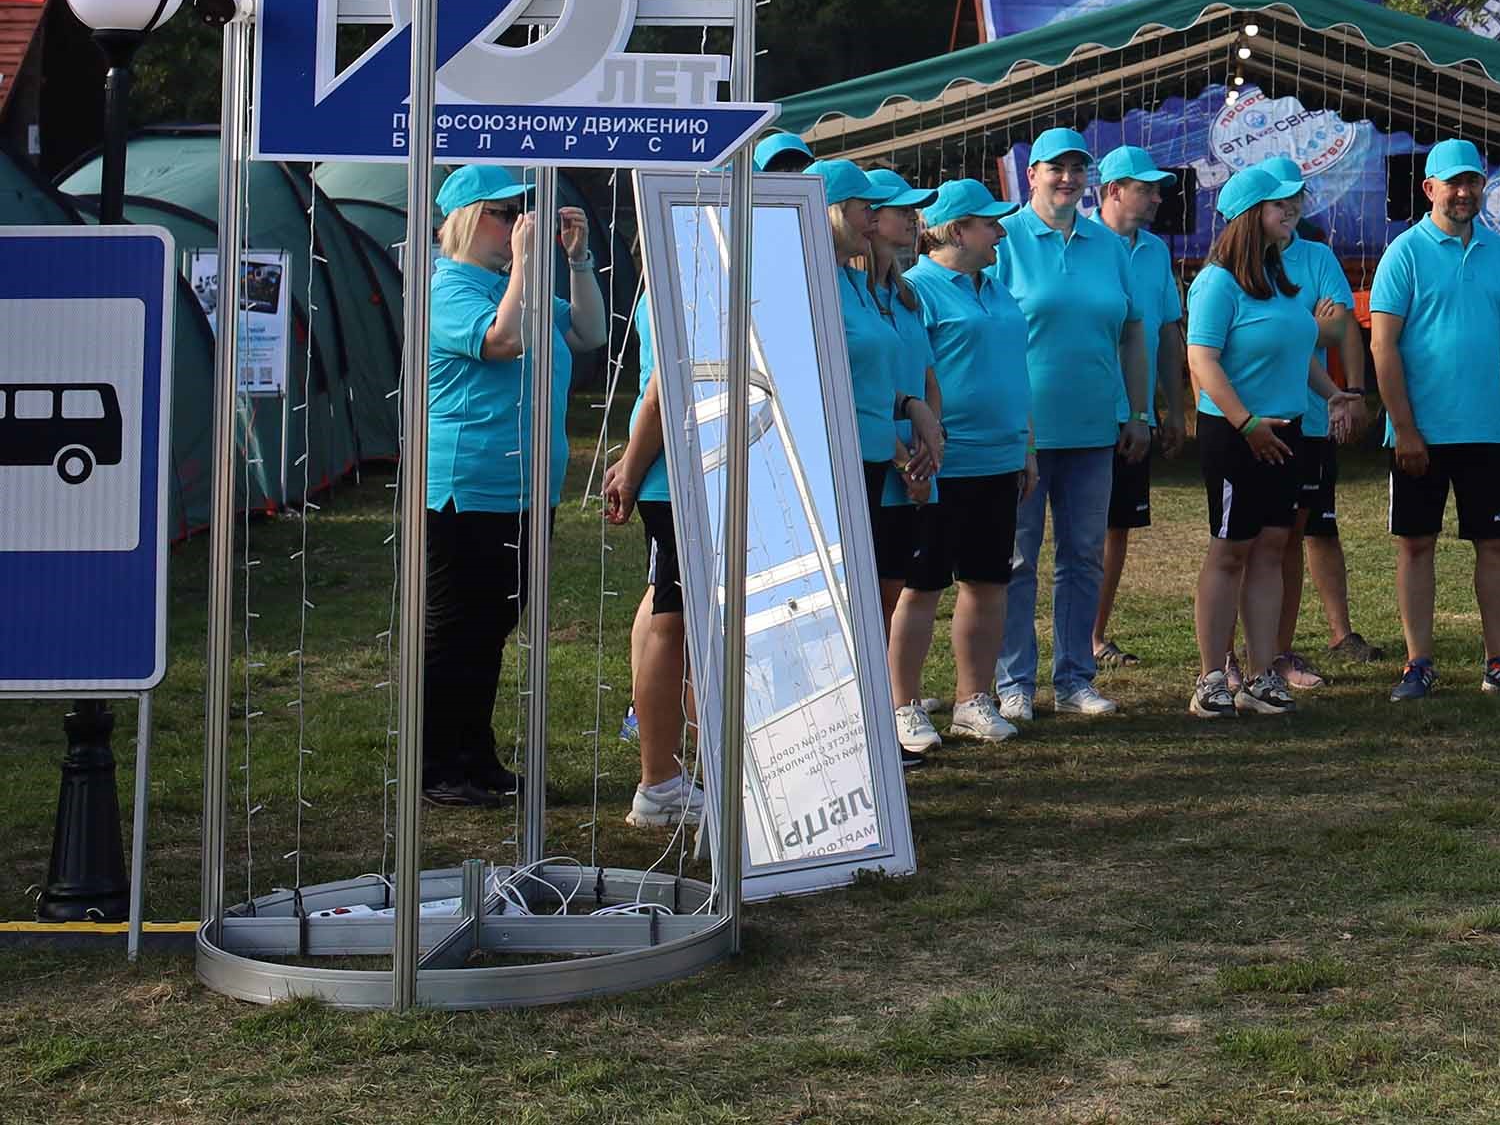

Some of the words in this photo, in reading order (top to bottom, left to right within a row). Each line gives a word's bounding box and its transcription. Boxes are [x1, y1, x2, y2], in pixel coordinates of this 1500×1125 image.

[597, 59, 717, 105] ЛЕТ
[393, 113, 577, 134] ПФСОЮЗНОМУ
[583, 118, 709, 136] ДВИЖЕНИЮ
